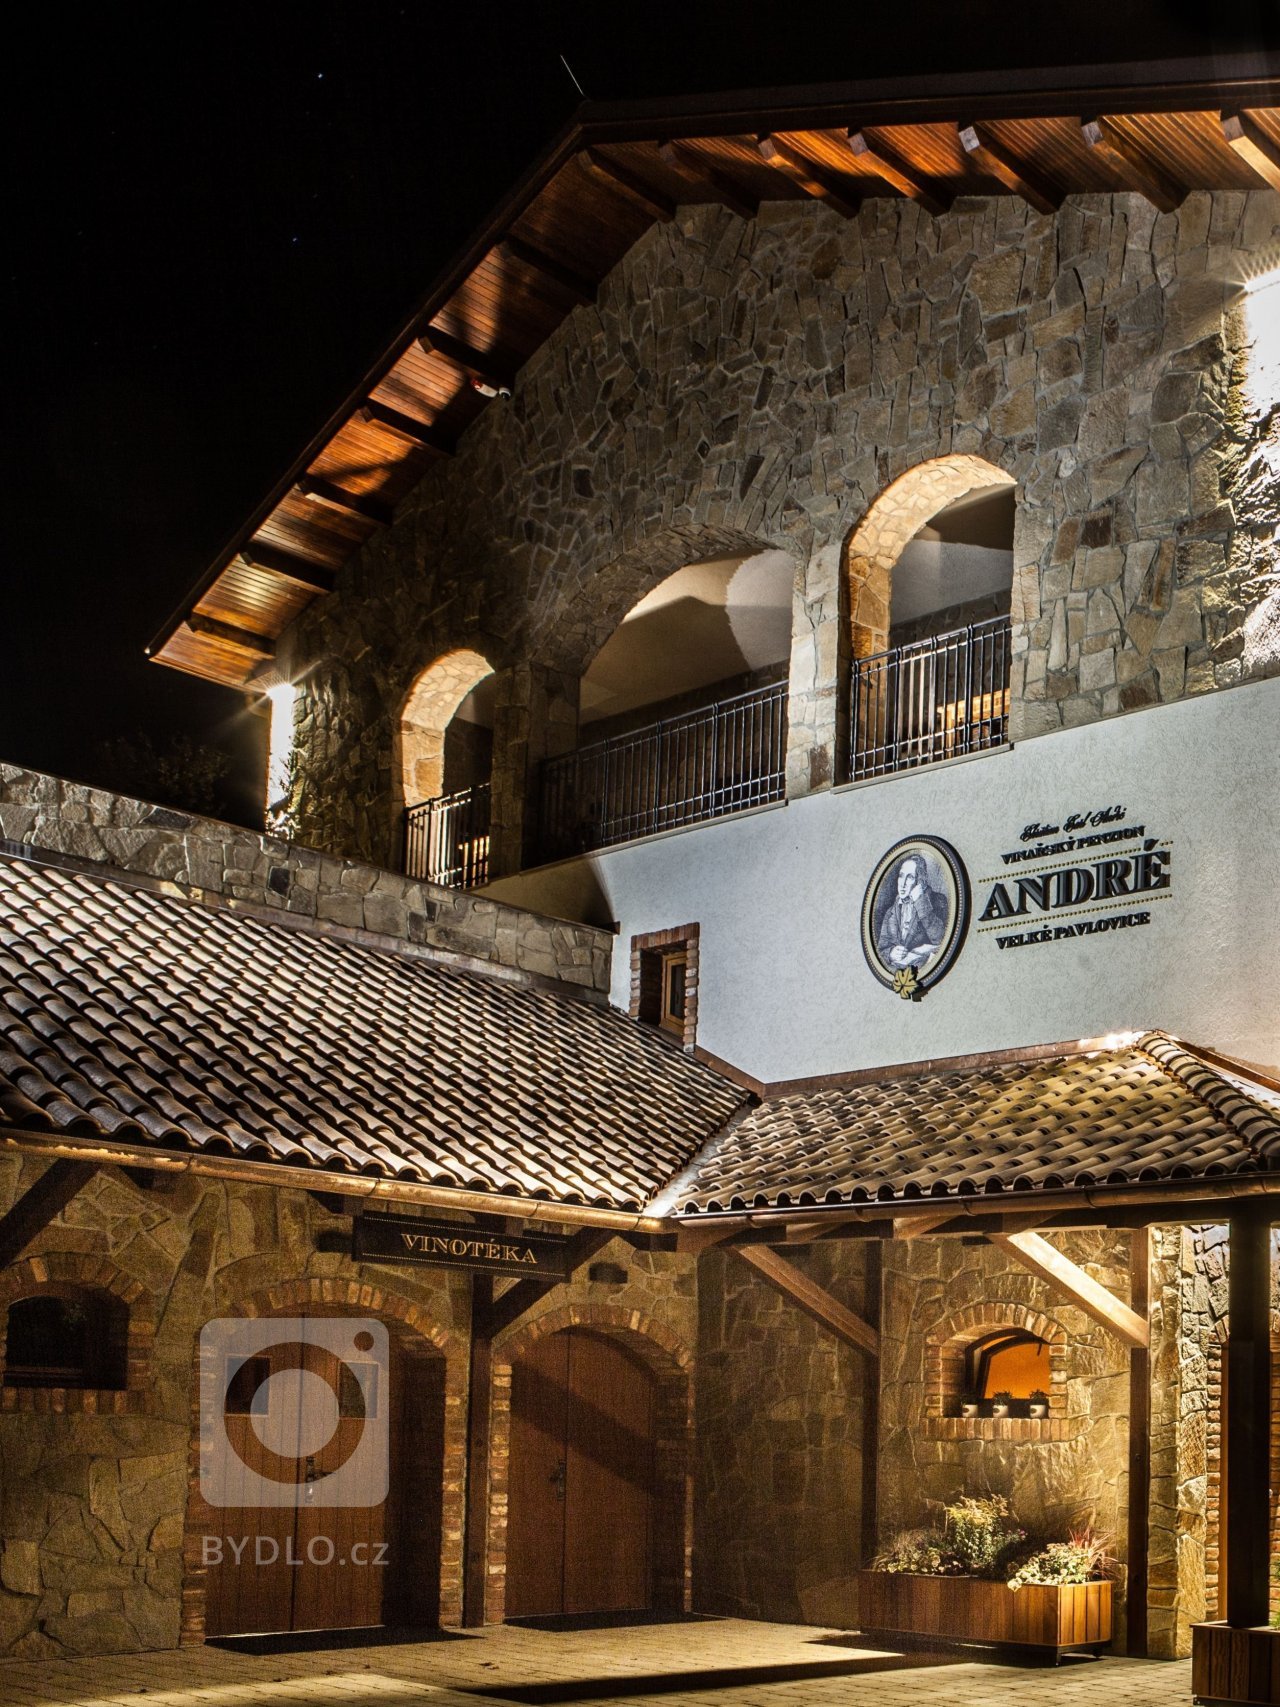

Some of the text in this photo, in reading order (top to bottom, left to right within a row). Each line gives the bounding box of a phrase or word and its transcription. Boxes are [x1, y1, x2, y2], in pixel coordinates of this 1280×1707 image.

[1076, 825, 1146, 850] PENZION
[977, 838, 1171, 921] ANDRÉ
[995, 911, 1151, 950] VELKÉ PAVLOVICE
[401, 1233, 538, 1264] VINOTÉKA
